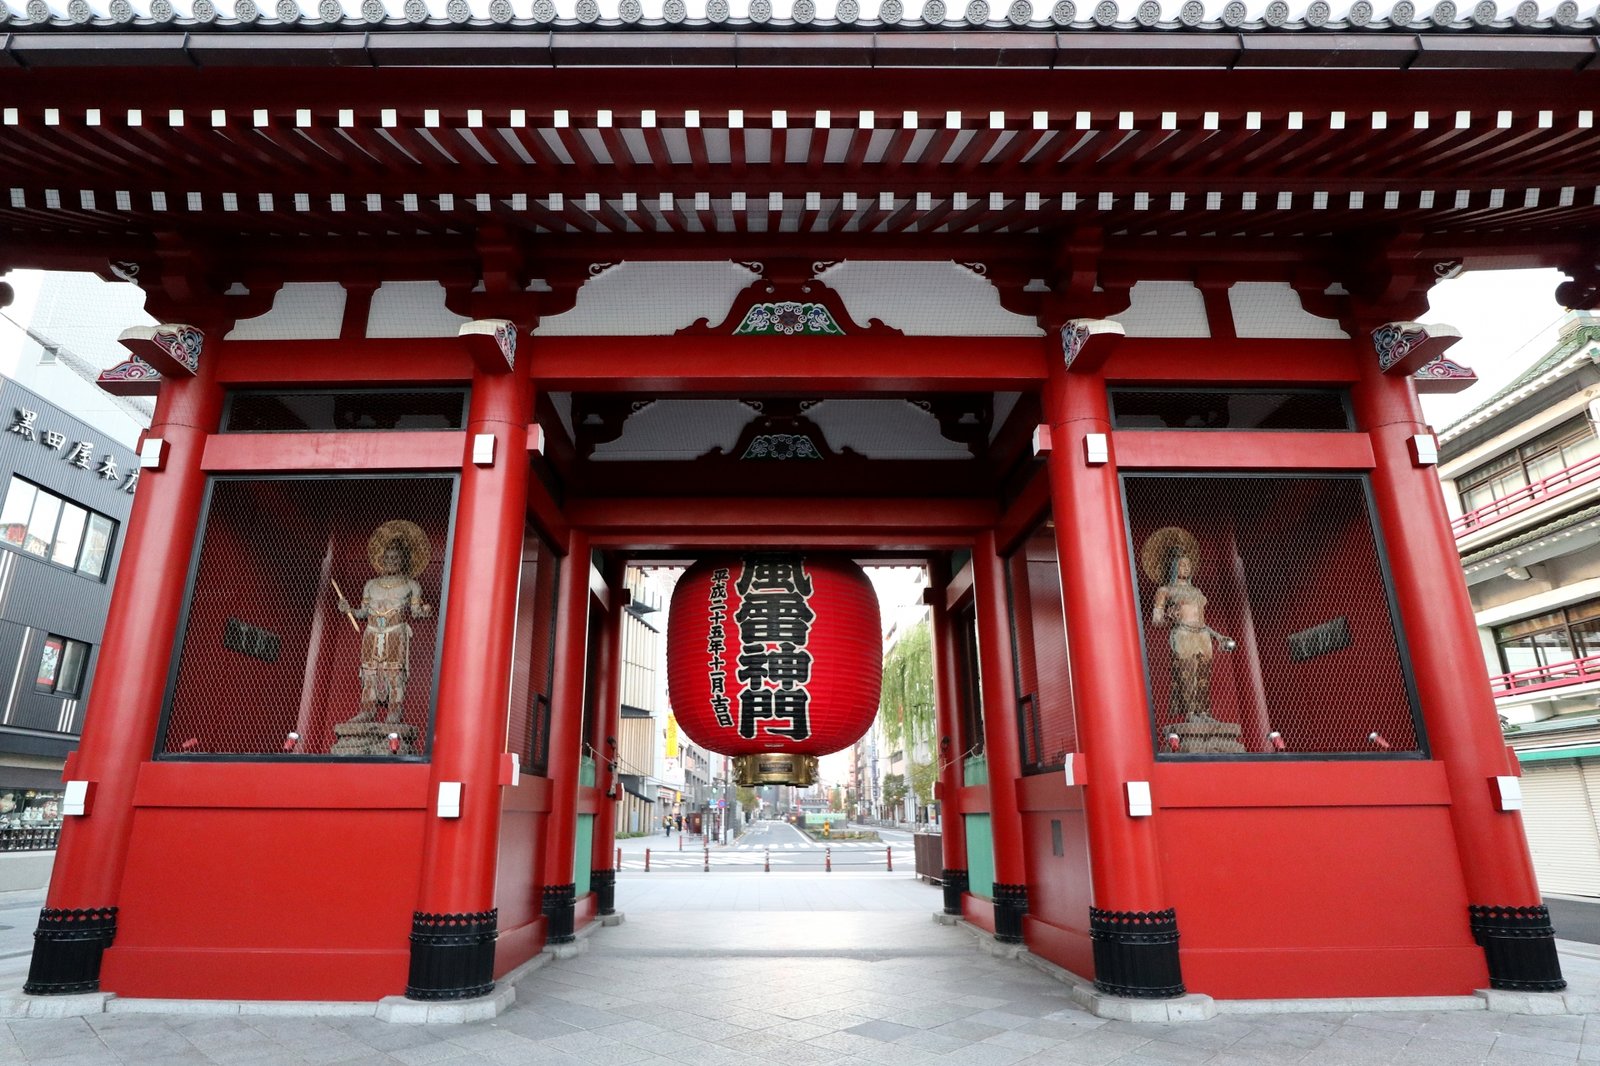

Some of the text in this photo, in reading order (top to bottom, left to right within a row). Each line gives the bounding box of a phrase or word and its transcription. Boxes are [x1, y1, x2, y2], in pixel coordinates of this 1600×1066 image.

[707, 568, 735, 727] 平成二十五年十一月吉日
[734, 555, 816, 741] 風雷神門
